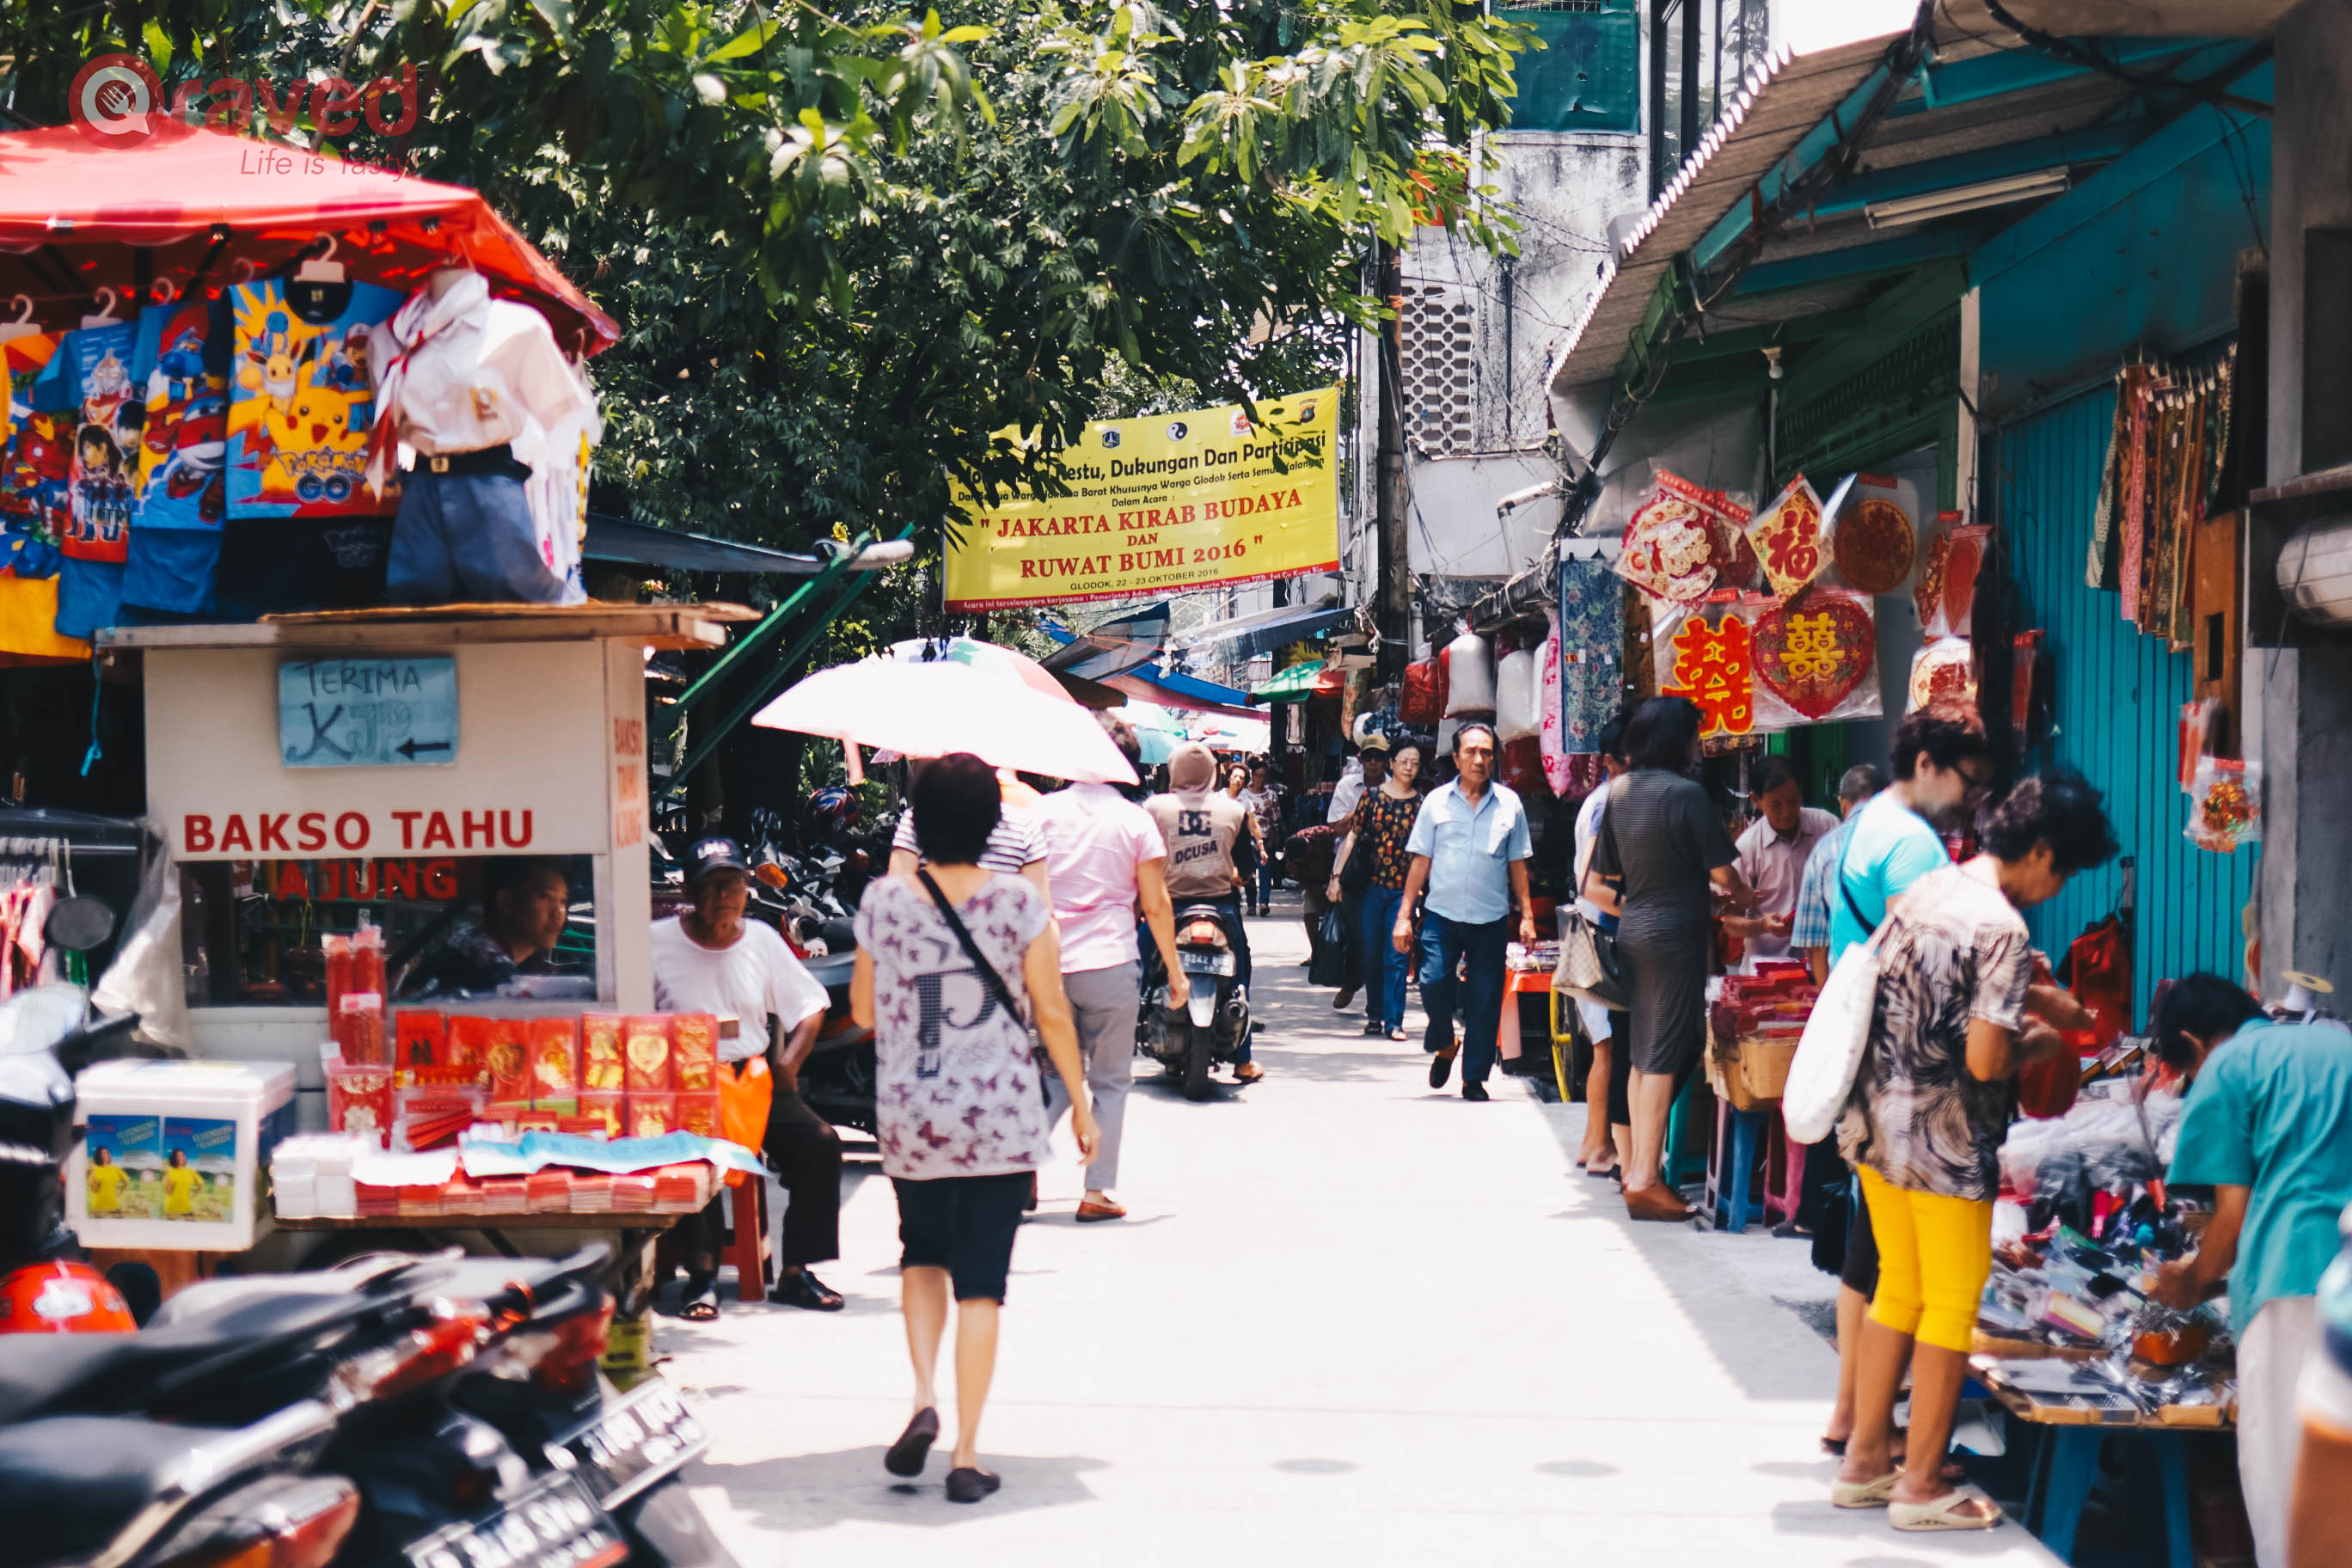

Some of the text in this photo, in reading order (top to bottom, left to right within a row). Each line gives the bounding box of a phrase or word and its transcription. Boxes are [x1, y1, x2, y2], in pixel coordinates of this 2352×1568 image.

[1061, 463, 1106, 482] estu,
[1111, 456, 1199, 479] Dukungan
[1204, 448, 1239, 468] Dan
[1081, 487, 1108, 497] Barat
[1110, 483, 1158, 495] Khususnya
[1160, 479, 1191, 490] Warga
[1193, 473, 1226, 486] Glodok
[1228, 470, 1250, 481] Serta
[1253, 466, 1282, 477] Semu
[996, 514, 1112, 537] JAKARTA
[1118, 504, 1196, 531] KIRAB
[1204, 488, 1303, 520] BUDAYA
[1112, 497, 1141, 507] Dalam
[1142, 494, 1168, 505] Acara
[1127, 532, 1159, 547] DAN
[1020, 554, 1112, 579] RUWAT
[1119, 547, 1185, 574] BUMI
[1193, 537, 1247, 564] 2016
[1069, 580, 1114, 591] GLODOK,
[1117, 579, 1128, 587] 22
[1136, 577, 1147, 585] 23
[1148, 571, 1196, 584] OKTOBER
[1197, 567, 1220, 578] 2016
[963, 601, 985, 609] Acara
[295, 659, 421, 697] TERIMA
[183, 809, 534, 853] BAKSO TAHU
[1174, 839, 1218, 865] DCUSA
[276, 860, 458, 902] AJUNG
